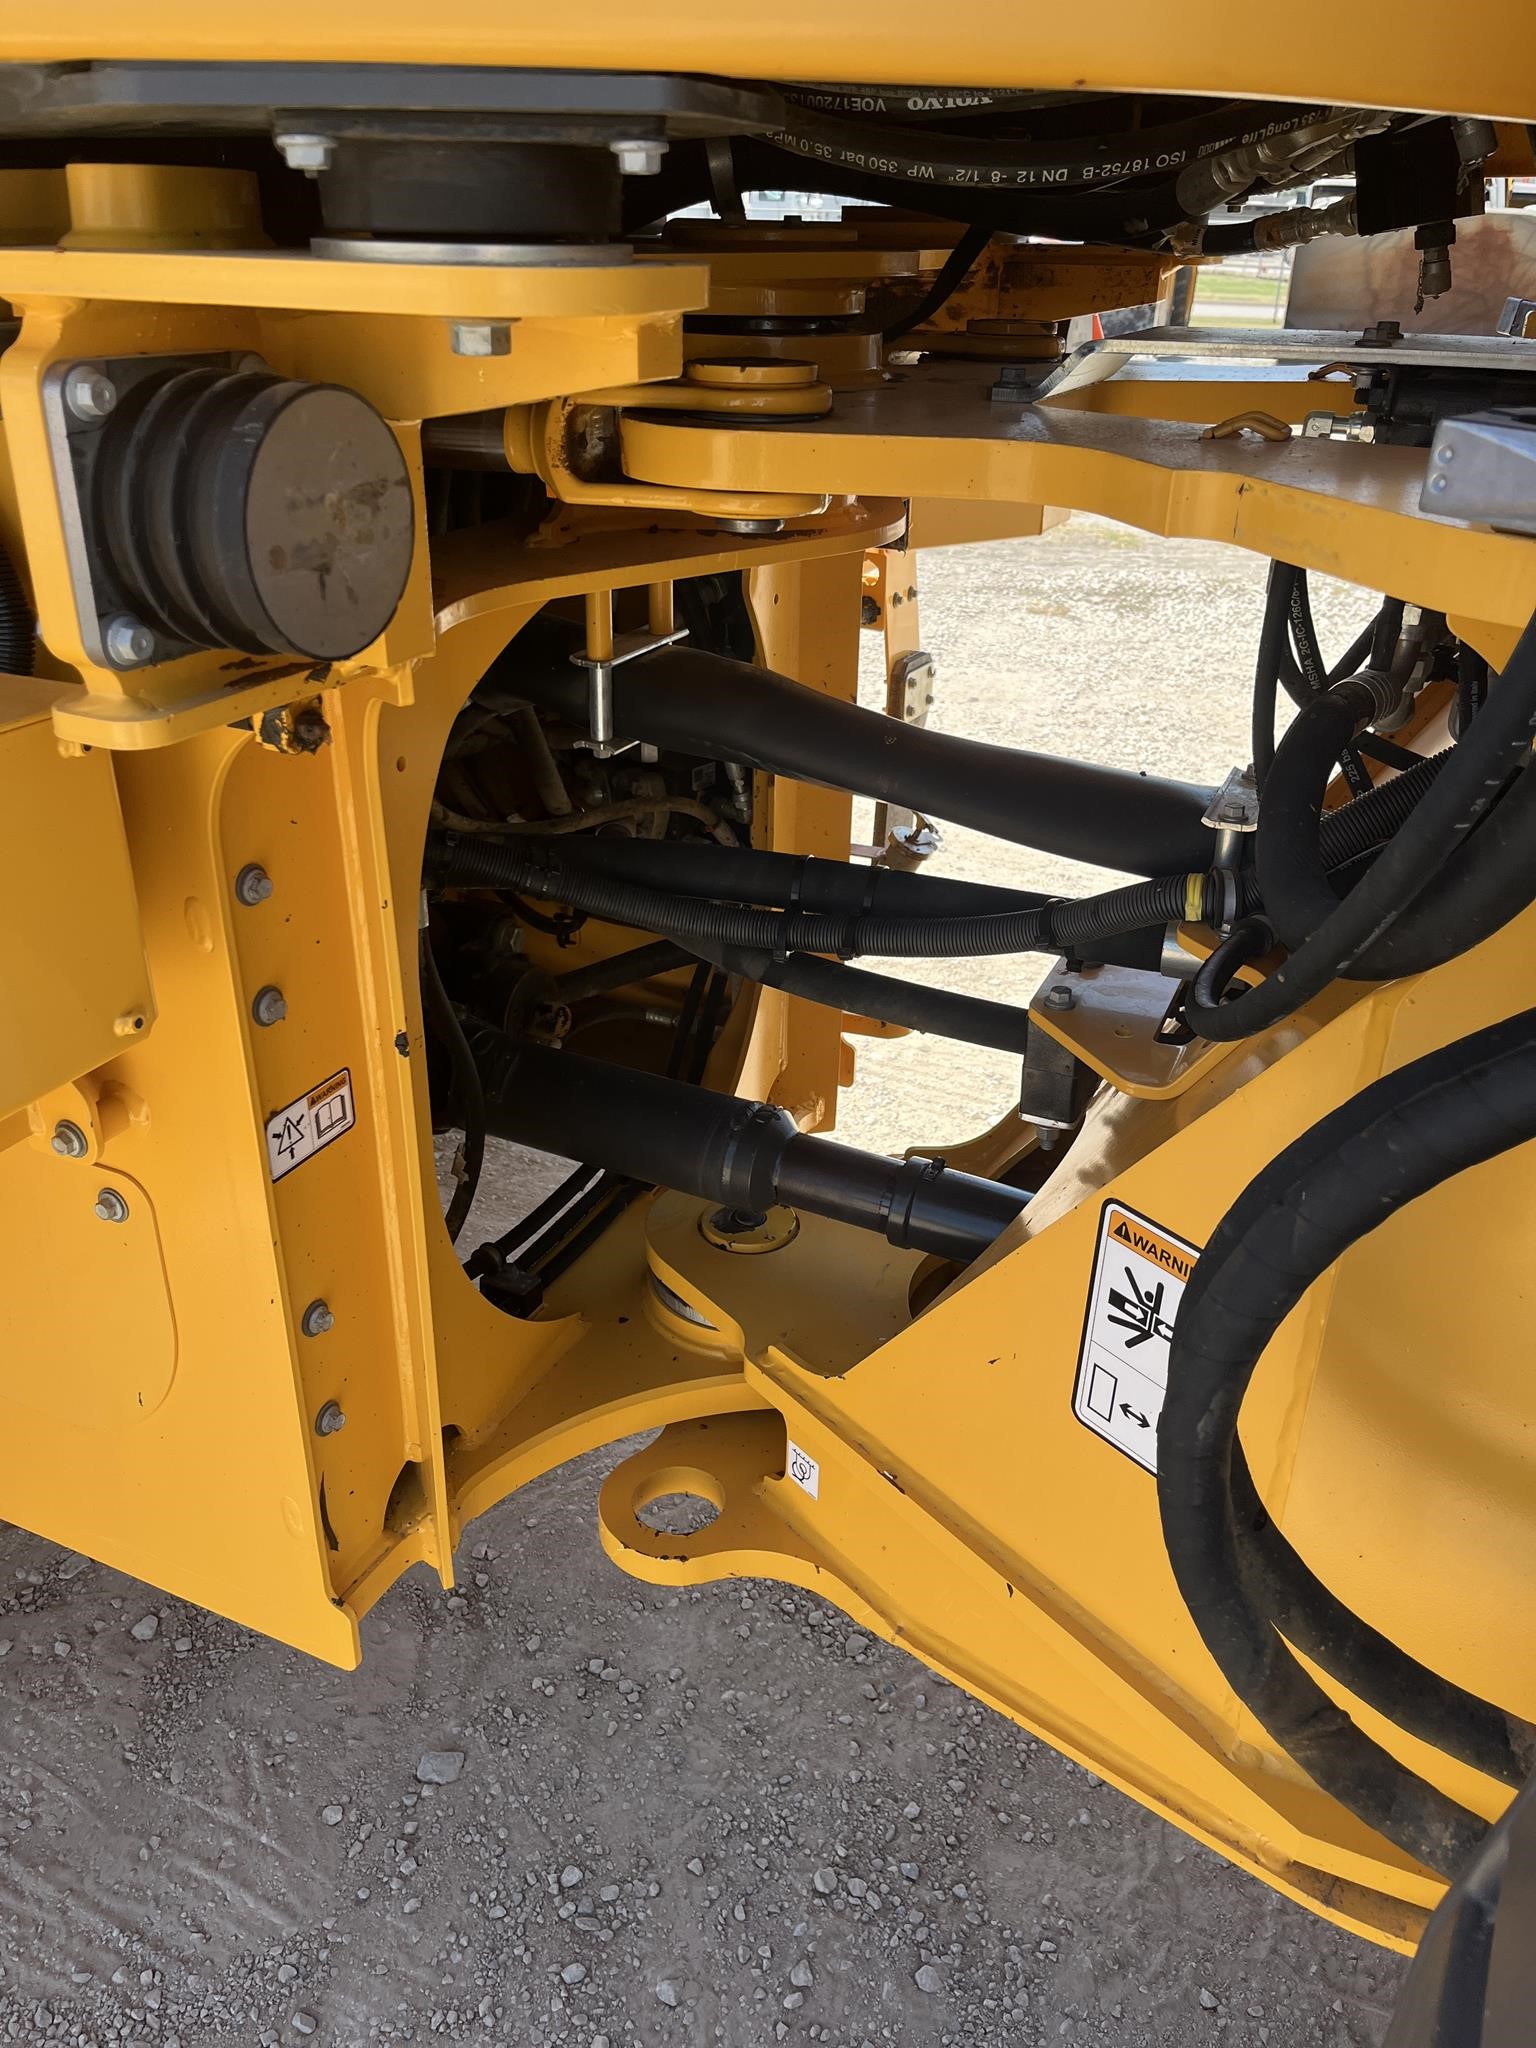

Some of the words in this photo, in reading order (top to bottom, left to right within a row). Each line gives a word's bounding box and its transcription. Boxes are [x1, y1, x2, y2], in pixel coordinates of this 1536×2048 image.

[907, 96, 993, 111] VOLVO
[766, 131, 797, 147] MPa
[800, 139, 832, 159] 35.0
[839, 150, 865, 167] bar
[868, 157, 898, 173] 350
[1155, 150, 1186, 168] ISO
[907, 164, 935, 180] WP
[991, 170, 1007, 183] -8
[1016, 170, 1036, 183] 12
[1042, 168, 1068, 182] DN
[1082, 158, 1149, 180] 18752-B
[1303, 657, 1321, 690] MSHA
[1346, 763, 1361, 783] 225
[316, 1077, 347, 1100] WARNING
[1132, 1232, 1194, 1278] WARNI
